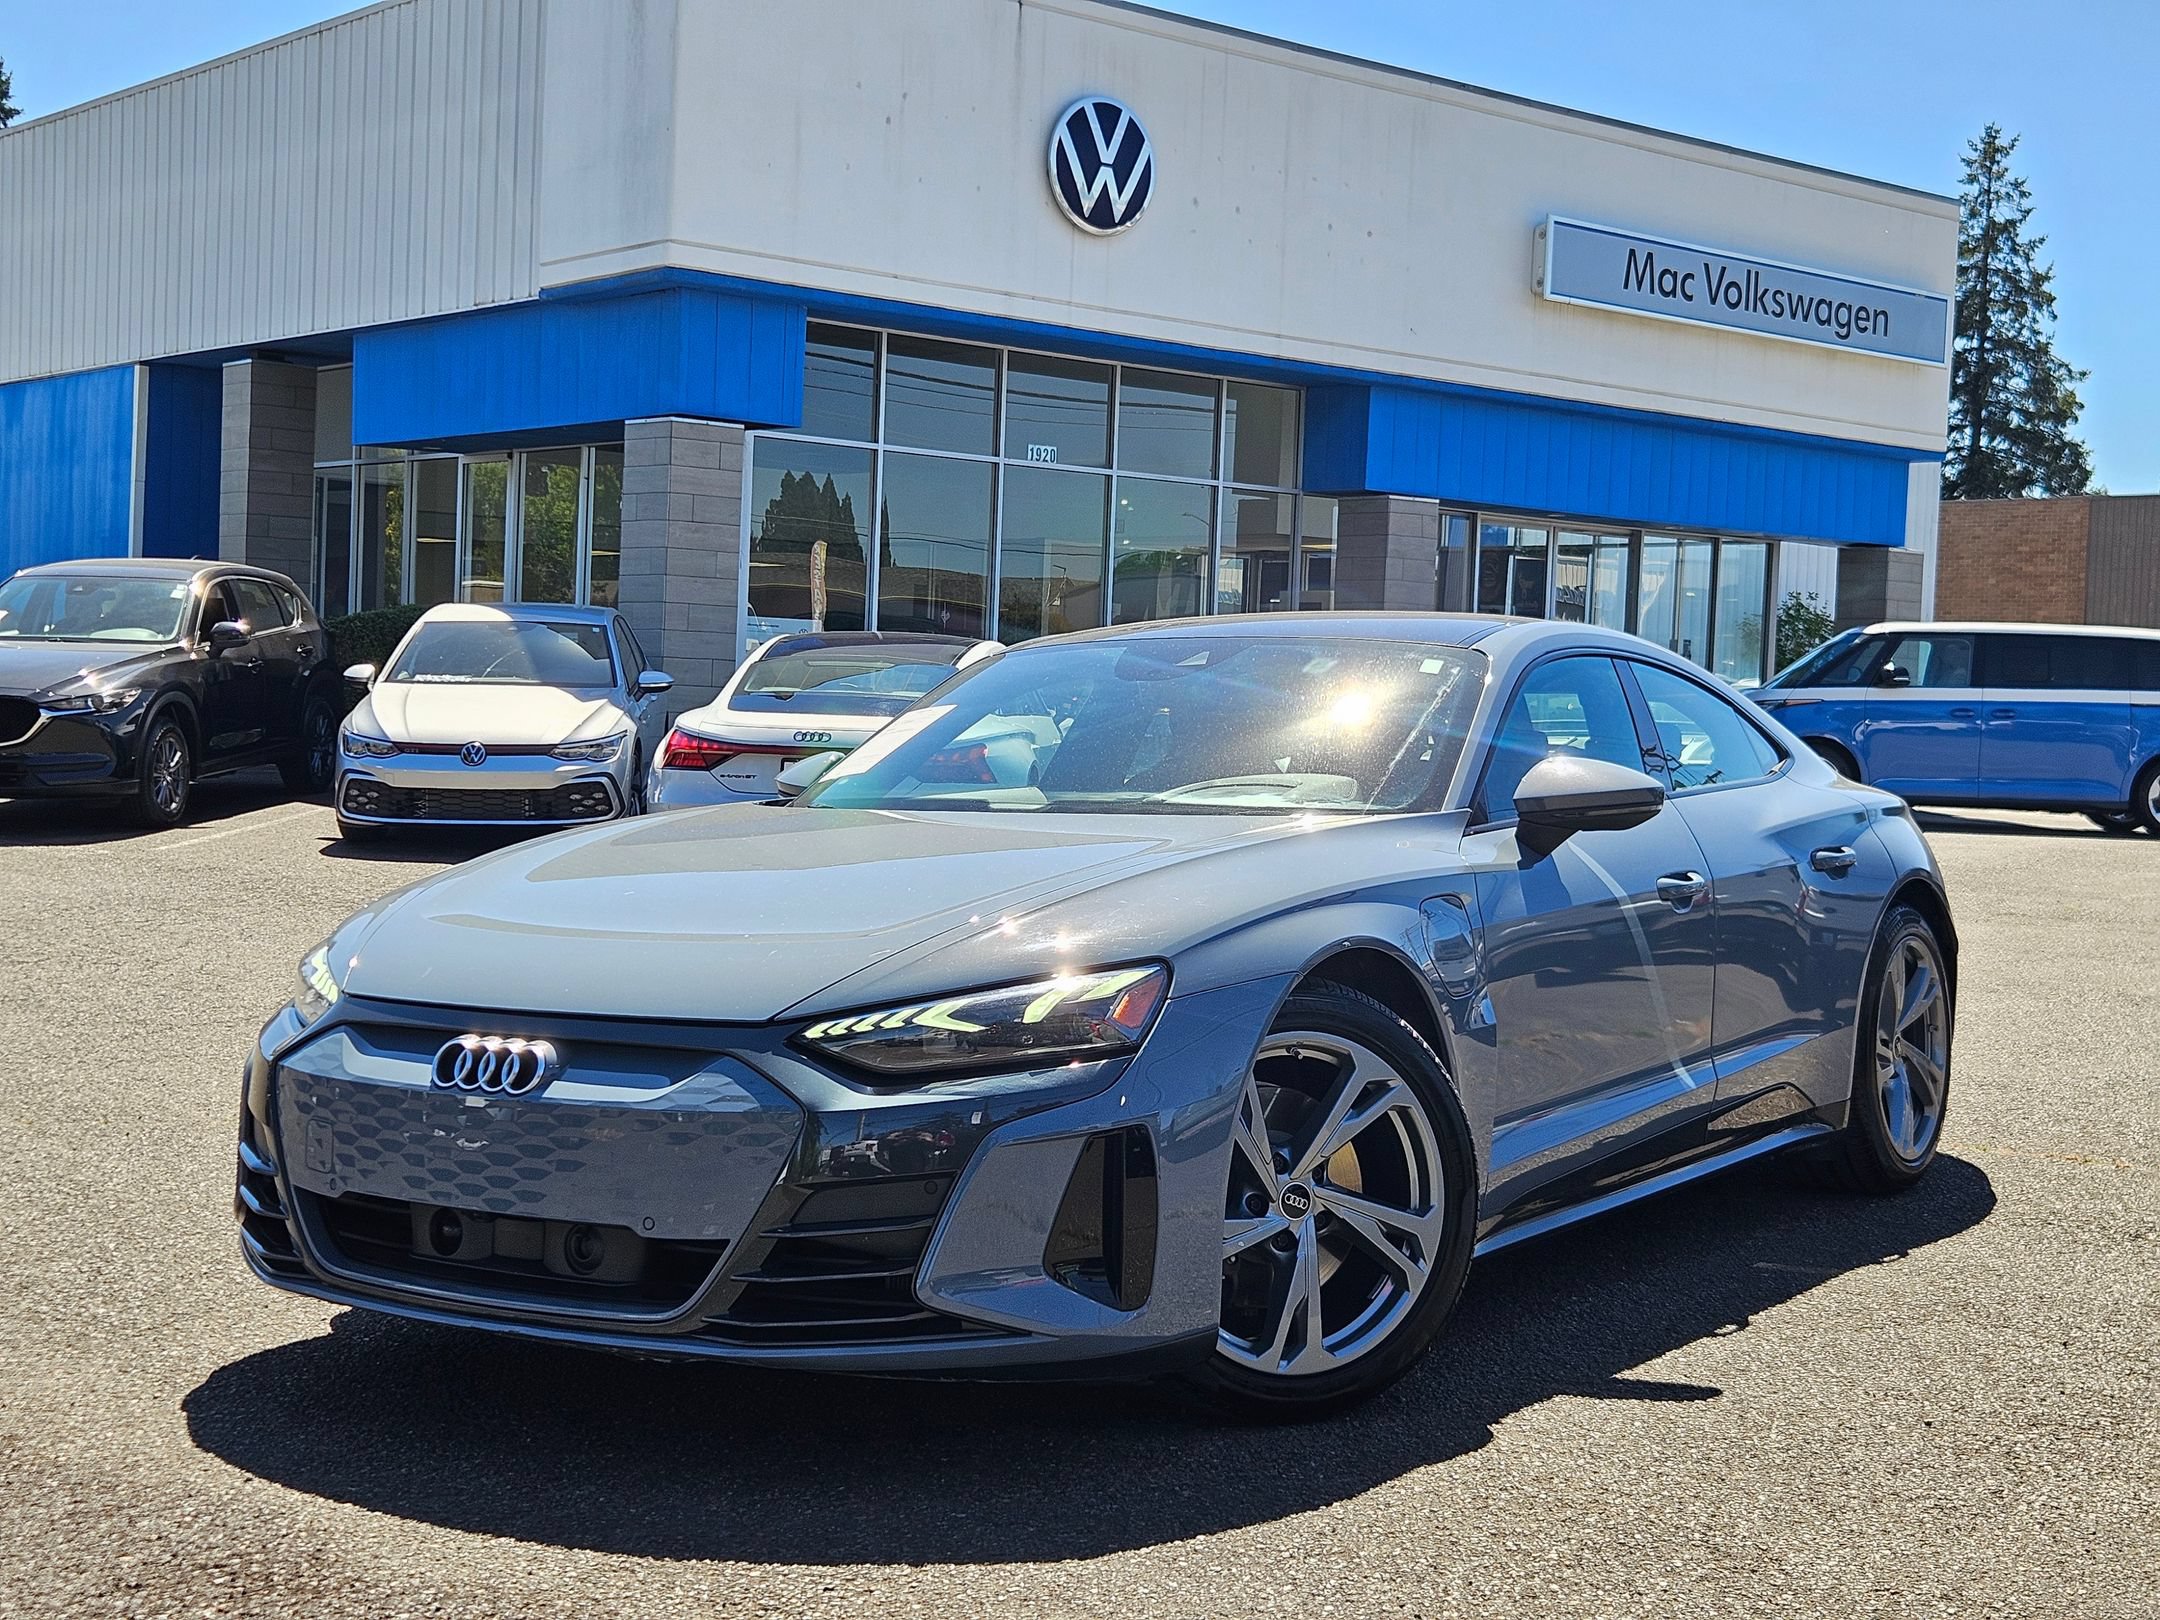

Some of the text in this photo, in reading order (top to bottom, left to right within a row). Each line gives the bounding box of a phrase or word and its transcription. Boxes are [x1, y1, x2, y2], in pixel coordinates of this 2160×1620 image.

[1053, 101, 1152, 225] VW
[1622, 247, 1889, 341] Mac Volkswagen
[1029, 446, 1056, 463] 1920
[462, 742, 485, 764] VW
